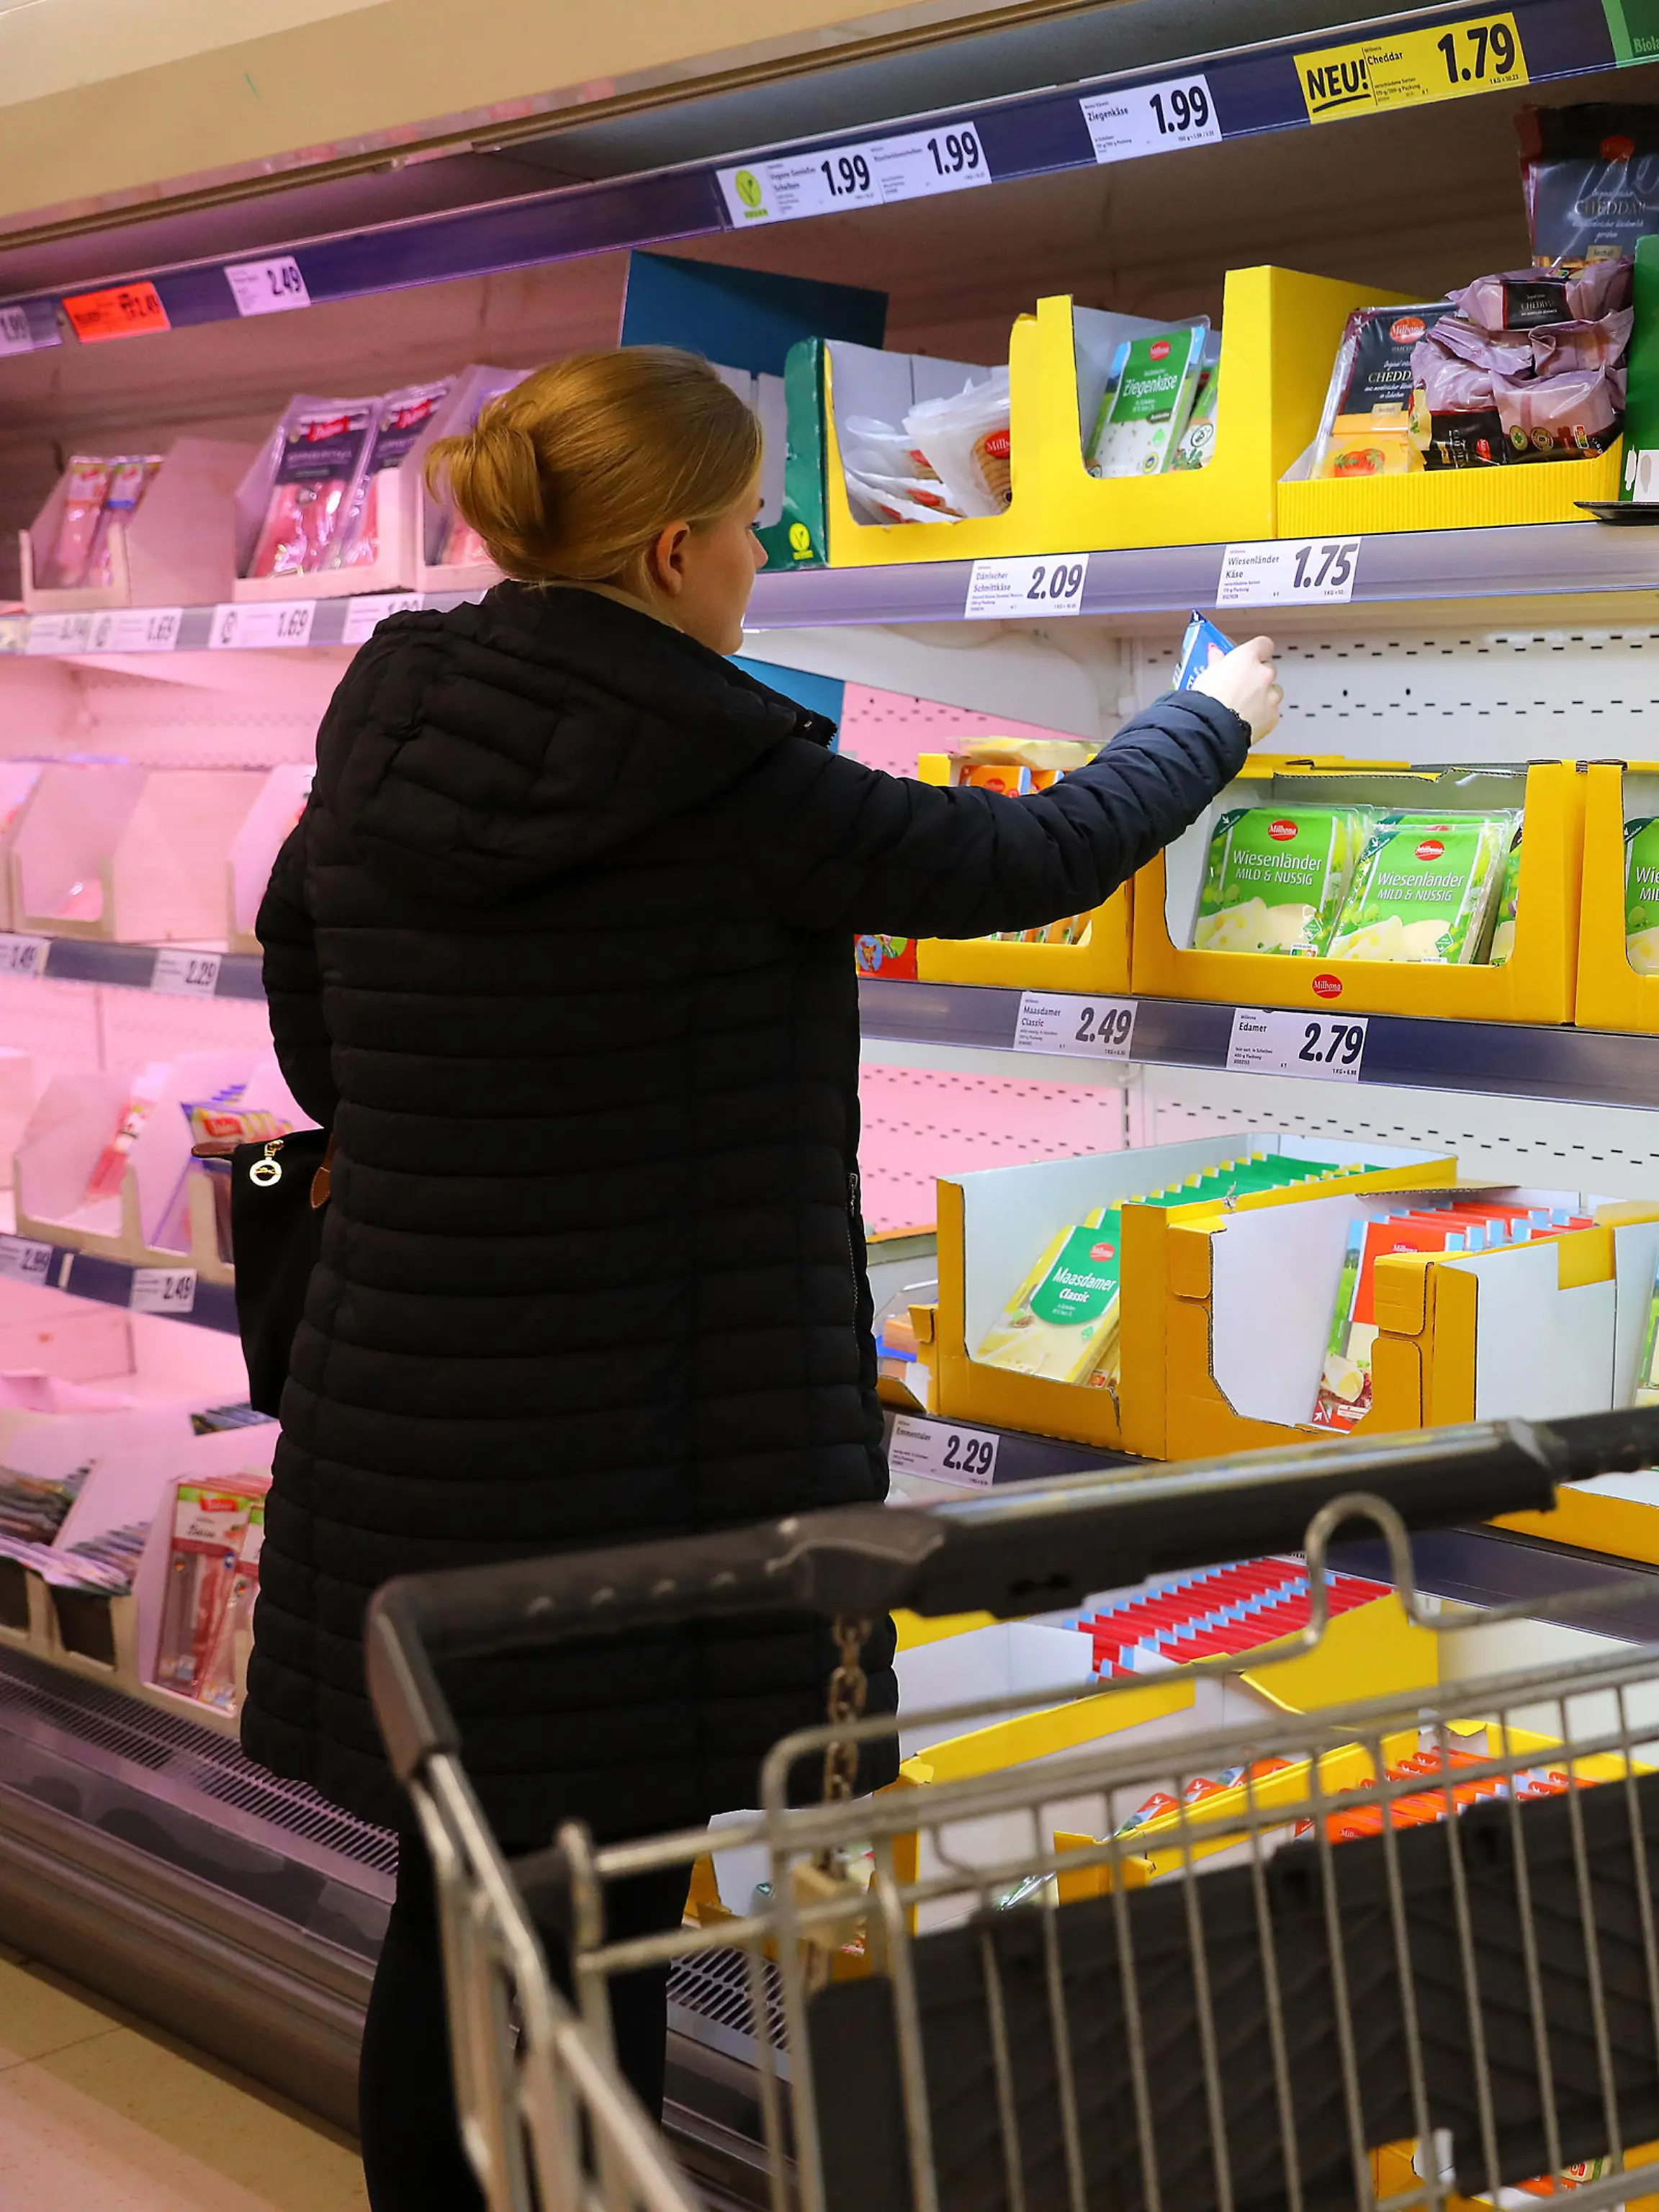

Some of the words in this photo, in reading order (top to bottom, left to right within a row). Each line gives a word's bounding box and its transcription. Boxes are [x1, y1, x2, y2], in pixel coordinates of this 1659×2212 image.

[1367, 52, 1403, 66] Cheddar
[1437, 23, 1515, 84] 1.79
[1306, 59, 1368, 100] NEU!
[1087, 107, 1128, 121] Ziegenkäse
[1149, 86, 1208, 134] 1.99
[927, 131, 979, 175] 1.99
[821, 155, 870, 196] 1.99
[1392, 324, 1424, 336] Milbona
[1368, 371, 1413, 382] CHEDD
[1123, 373, 1178, 398] Ziegenkäse
[1228, 554, 1279, 566] Wiesenländer
[1294, 543, 1359, 588] 1.75
[976, 572, 1008, 580] Dänischer
[1027, 564, 1083, 599] 2.09
[1226, 570, 1244, 579] Käse
[974, 583, 1011, 593] Schnittkäse
[1269, 824, 1297, 835] Milbona
[1233, 850, 1322, 872] Wiesenländer
[1236, 868, 1261, 881] MILD
[1264, 869, 1272, 881] &
[1274, 871, 1313, 885] NUSSIG
[1377, 871, 1465, 888] Wiesenländer
[1377, 889, 1403, 901] MILD
[1405, 889, 1413, 900] &
[1416, 890, 1453, 902] NUSSIG
[1313, 980, 1341, 991] Milbona
[1023, 1006, 1061, 1016] Maasdamer
[1021, 1017, 1044, 1027] Classic
[1075, 1007, 1132, 1045] 2.49
[1239, 1022, 1267, 1033] Edamer
[1299, 1022, 1364, 1065] 2.79
[1052, 1267, 1117, 1291] Maasdamer
[1059, 1287, 1090, 1303] Classic
[896, 1427, 931, 1441] Emmentaler
[943, 1435, 993, 1475] 2.29
